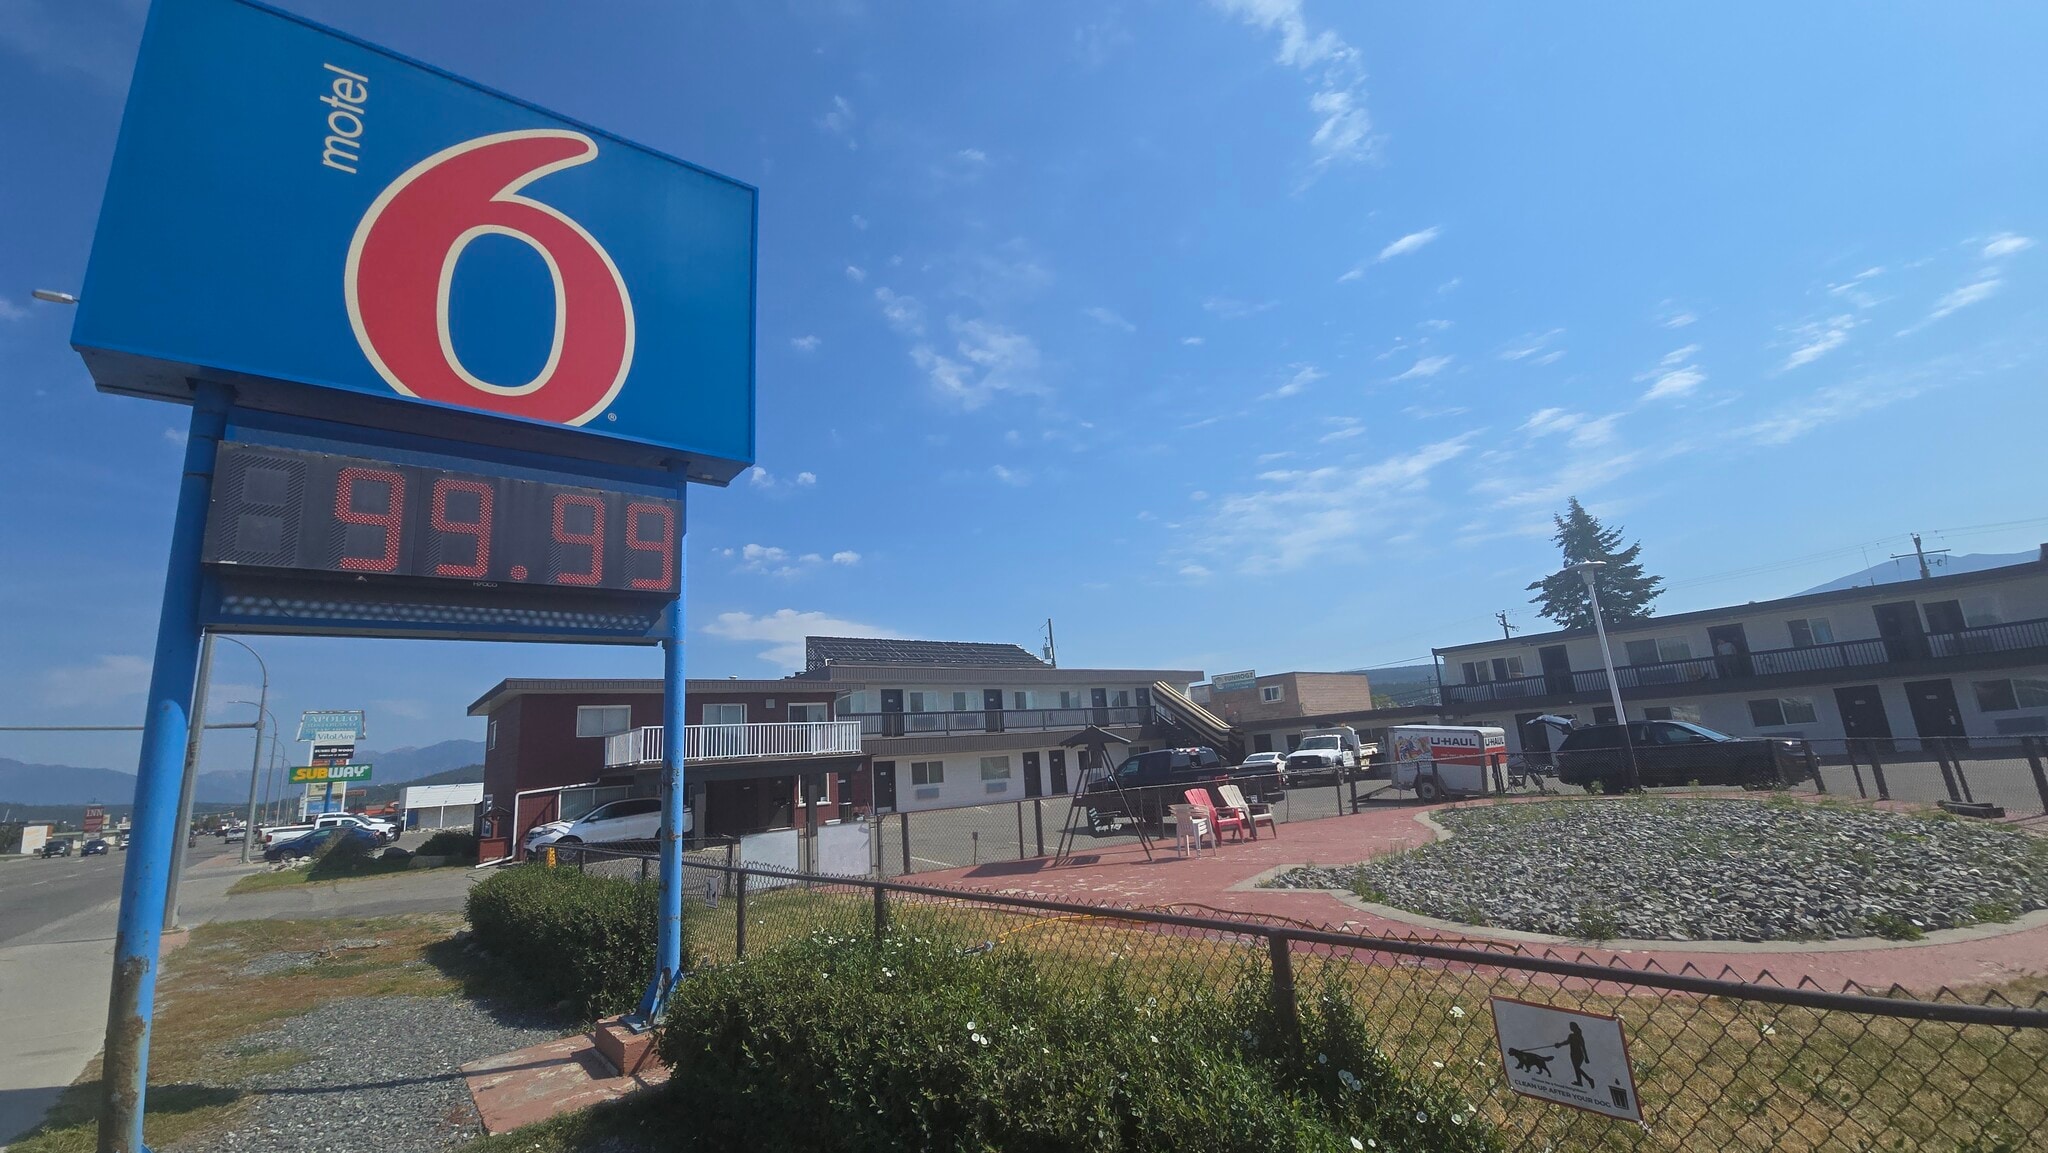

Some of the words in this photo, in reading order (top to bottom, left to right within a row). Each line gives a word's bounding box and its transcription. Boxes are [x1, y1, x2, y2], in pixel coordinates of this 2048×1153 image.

[319, 62, 369, 174] motel
[344, 128, 636, 427] 6
[311, 715, 358, 723] APOLLO
[1430, 737, 1476, 746] U-HAUL
[293, 766, 370, 781] SUBWAY
[1514, 1079, 1537, 1090] CLEAN
[1537, 1084, 1548, 1092] UP
[1549, 1086, 1571, 1098] AFTER
[1571, 1093, 1594, 1104] YOUR
[1594, 1099, 1612, 1109] DOG
